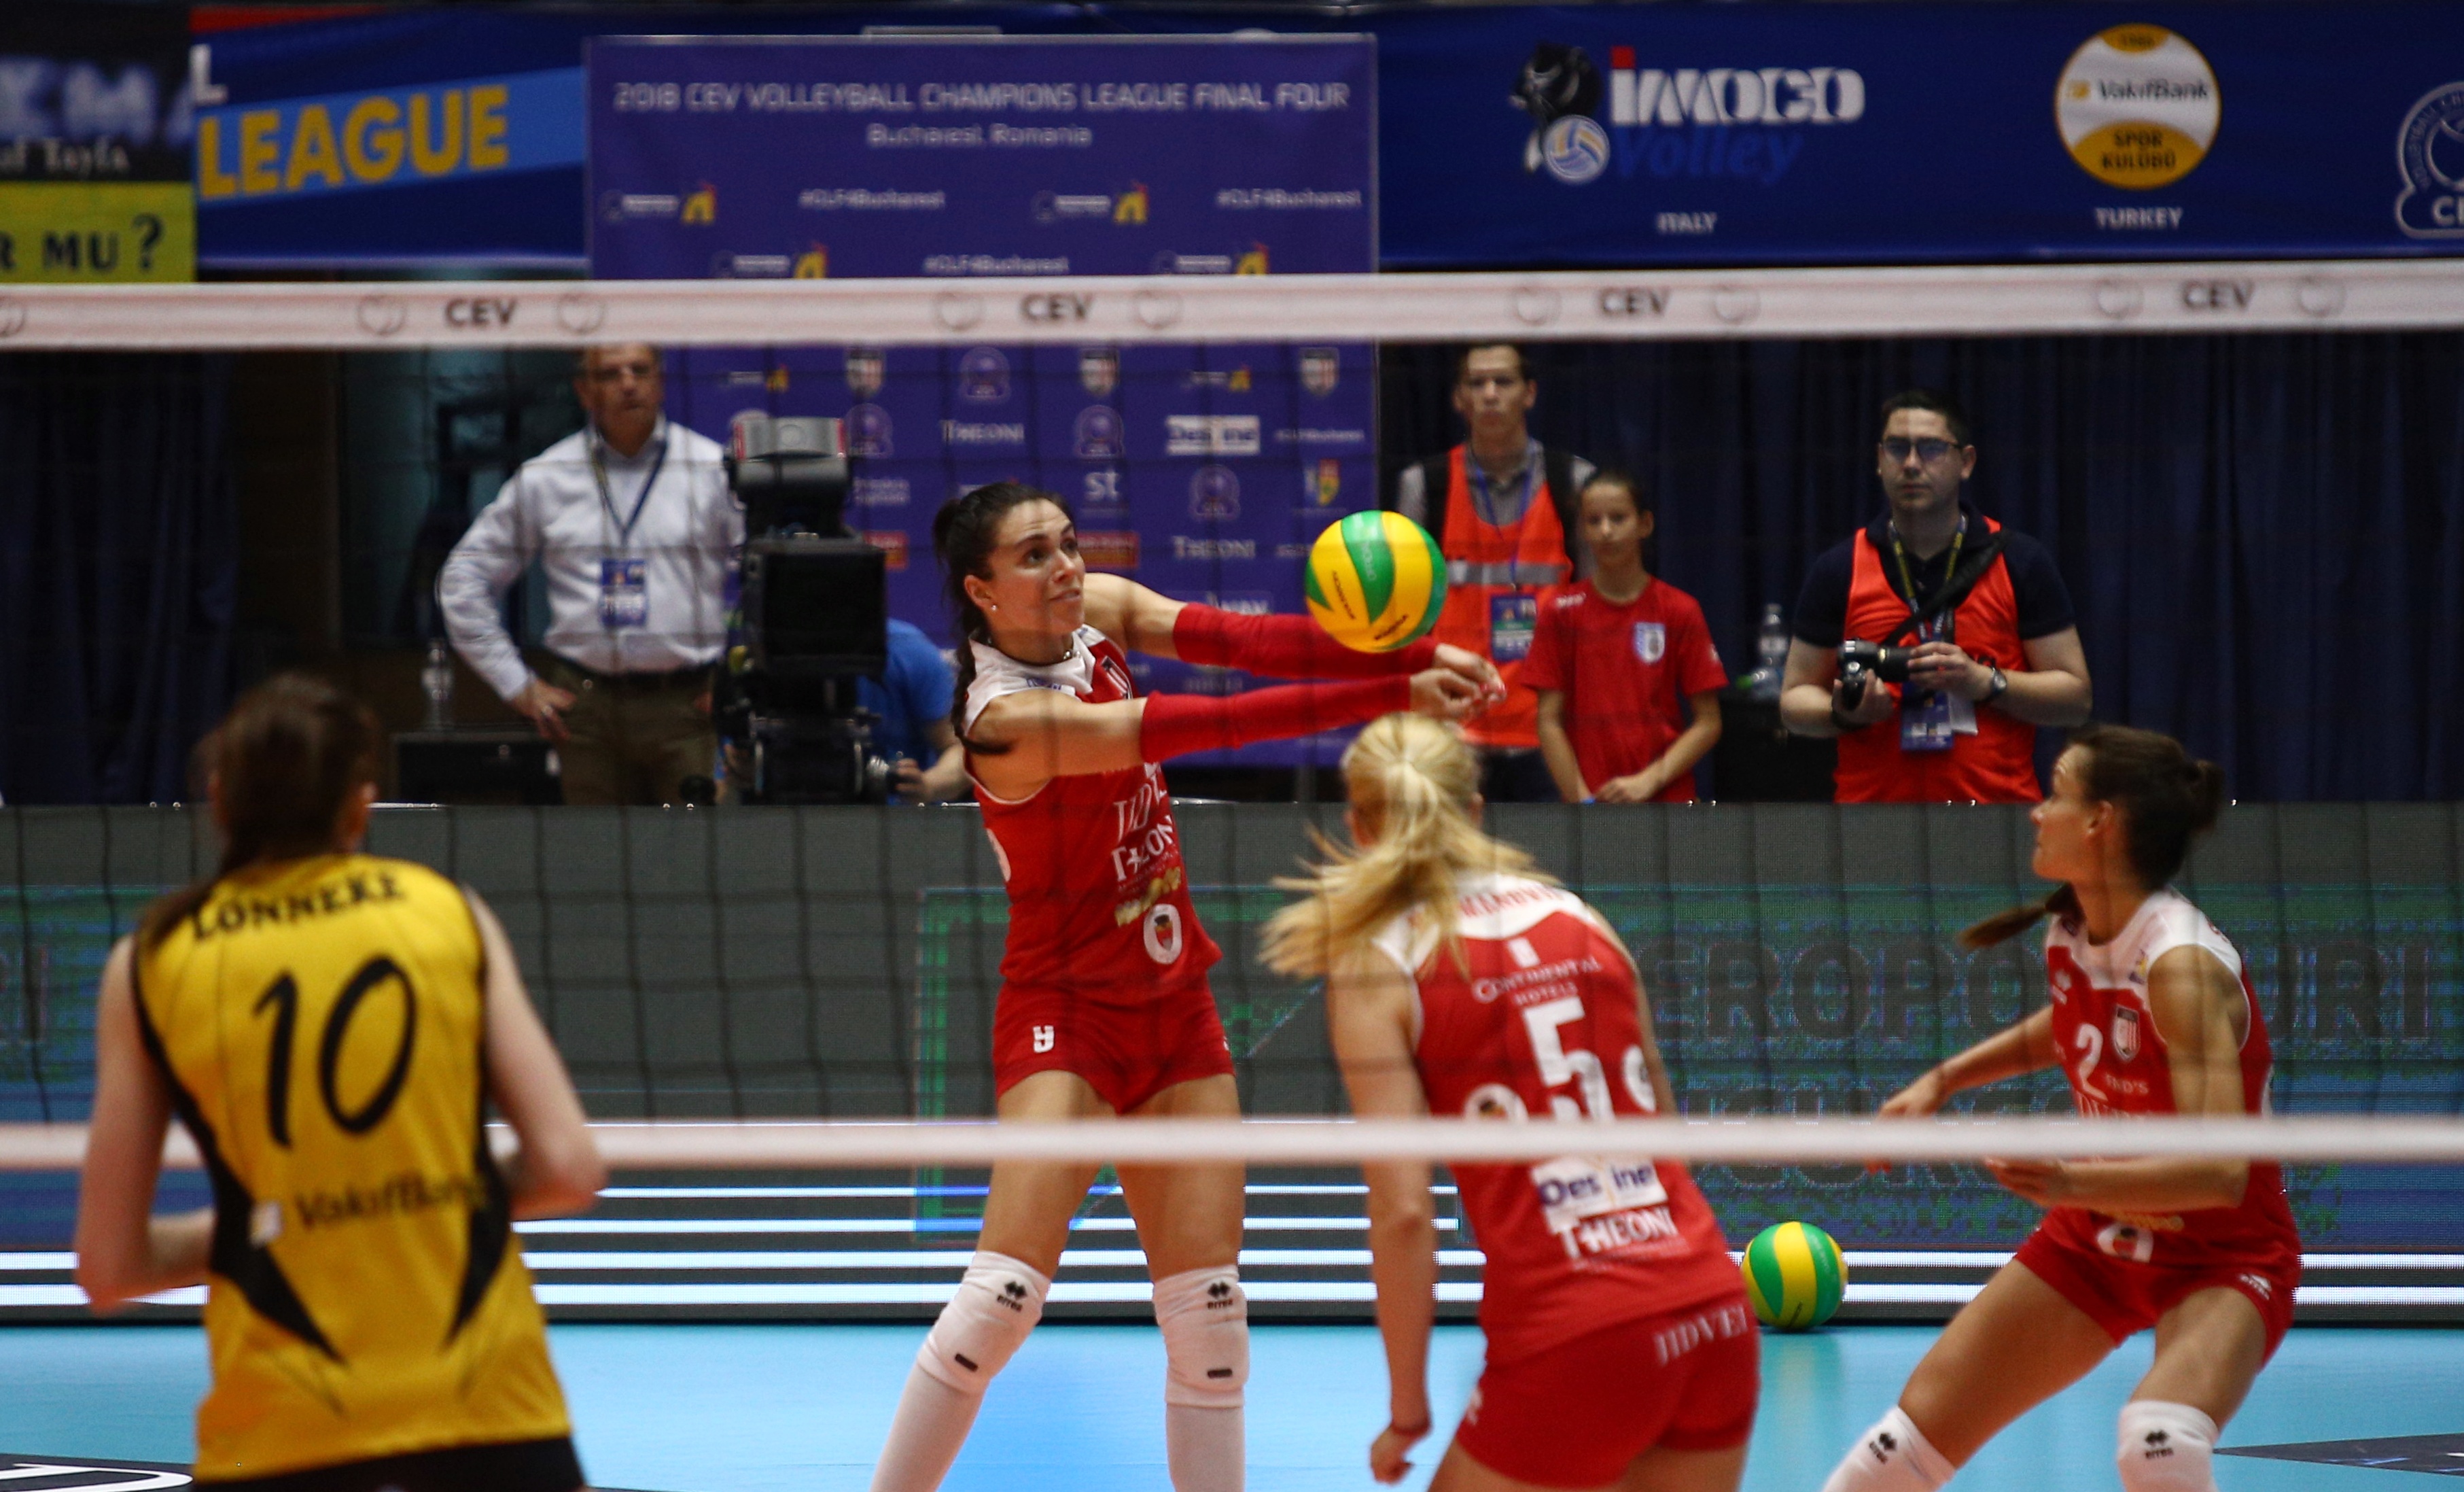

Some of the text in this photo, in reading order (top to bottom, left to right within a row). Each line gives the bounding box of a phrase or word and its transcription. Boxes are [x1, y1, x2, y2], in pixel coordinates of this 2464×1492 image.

[614, 82, 1351, 111] 2018 CEV VOLLEYBALL CHAMPIONS LEAGUE FINAL FOUR
[198, 84, 508, 199] LEAGUE
[1656, 212, 1717, 235] ITALY
[2094, 207, 2184, 230] TURKEY
[1020, 293, 1093, 323] CEV
[1598, 288, 1672, 317] CEV
[2183, 280, 2255, 311] CEV
[444, 298, 517, 328] CEV
[253, 954, 419, 1151] 10
[1523, 996, 1613, 1122] 5
[2073, 1022, 2109, 1103] 2
